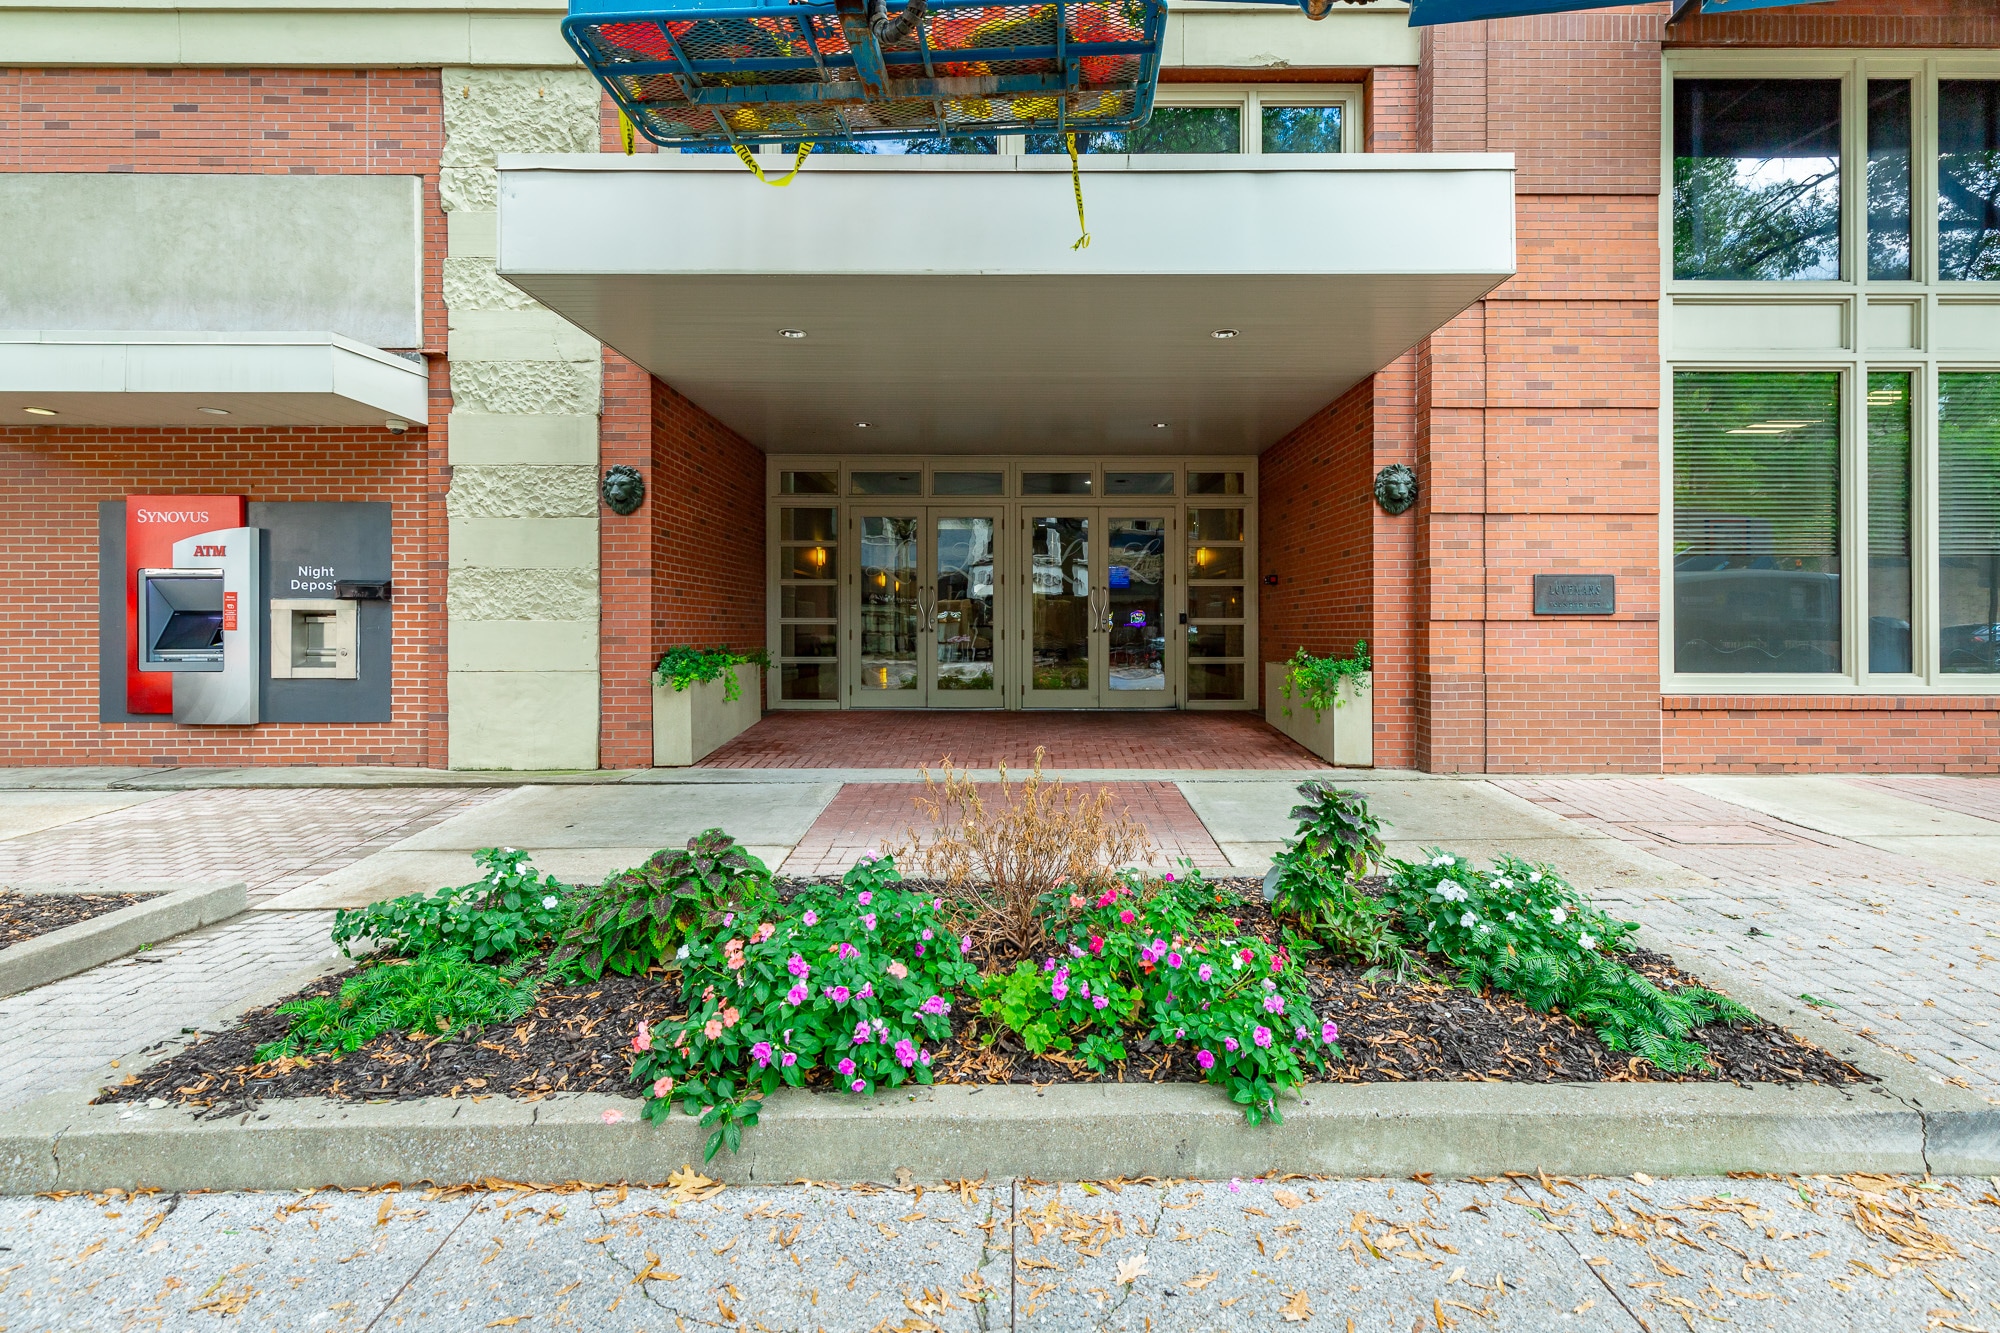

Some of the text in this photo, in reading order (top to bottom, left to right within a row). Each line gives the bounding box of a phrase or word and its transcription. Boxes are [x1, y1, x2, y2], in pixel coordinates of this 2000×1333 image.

[137, 508, 209, 523] SYNOVUS
[193, 545, 227, 557] ATM
[298, 565, 335, 579] Night
[290, 579, 337, 592] Deposi
